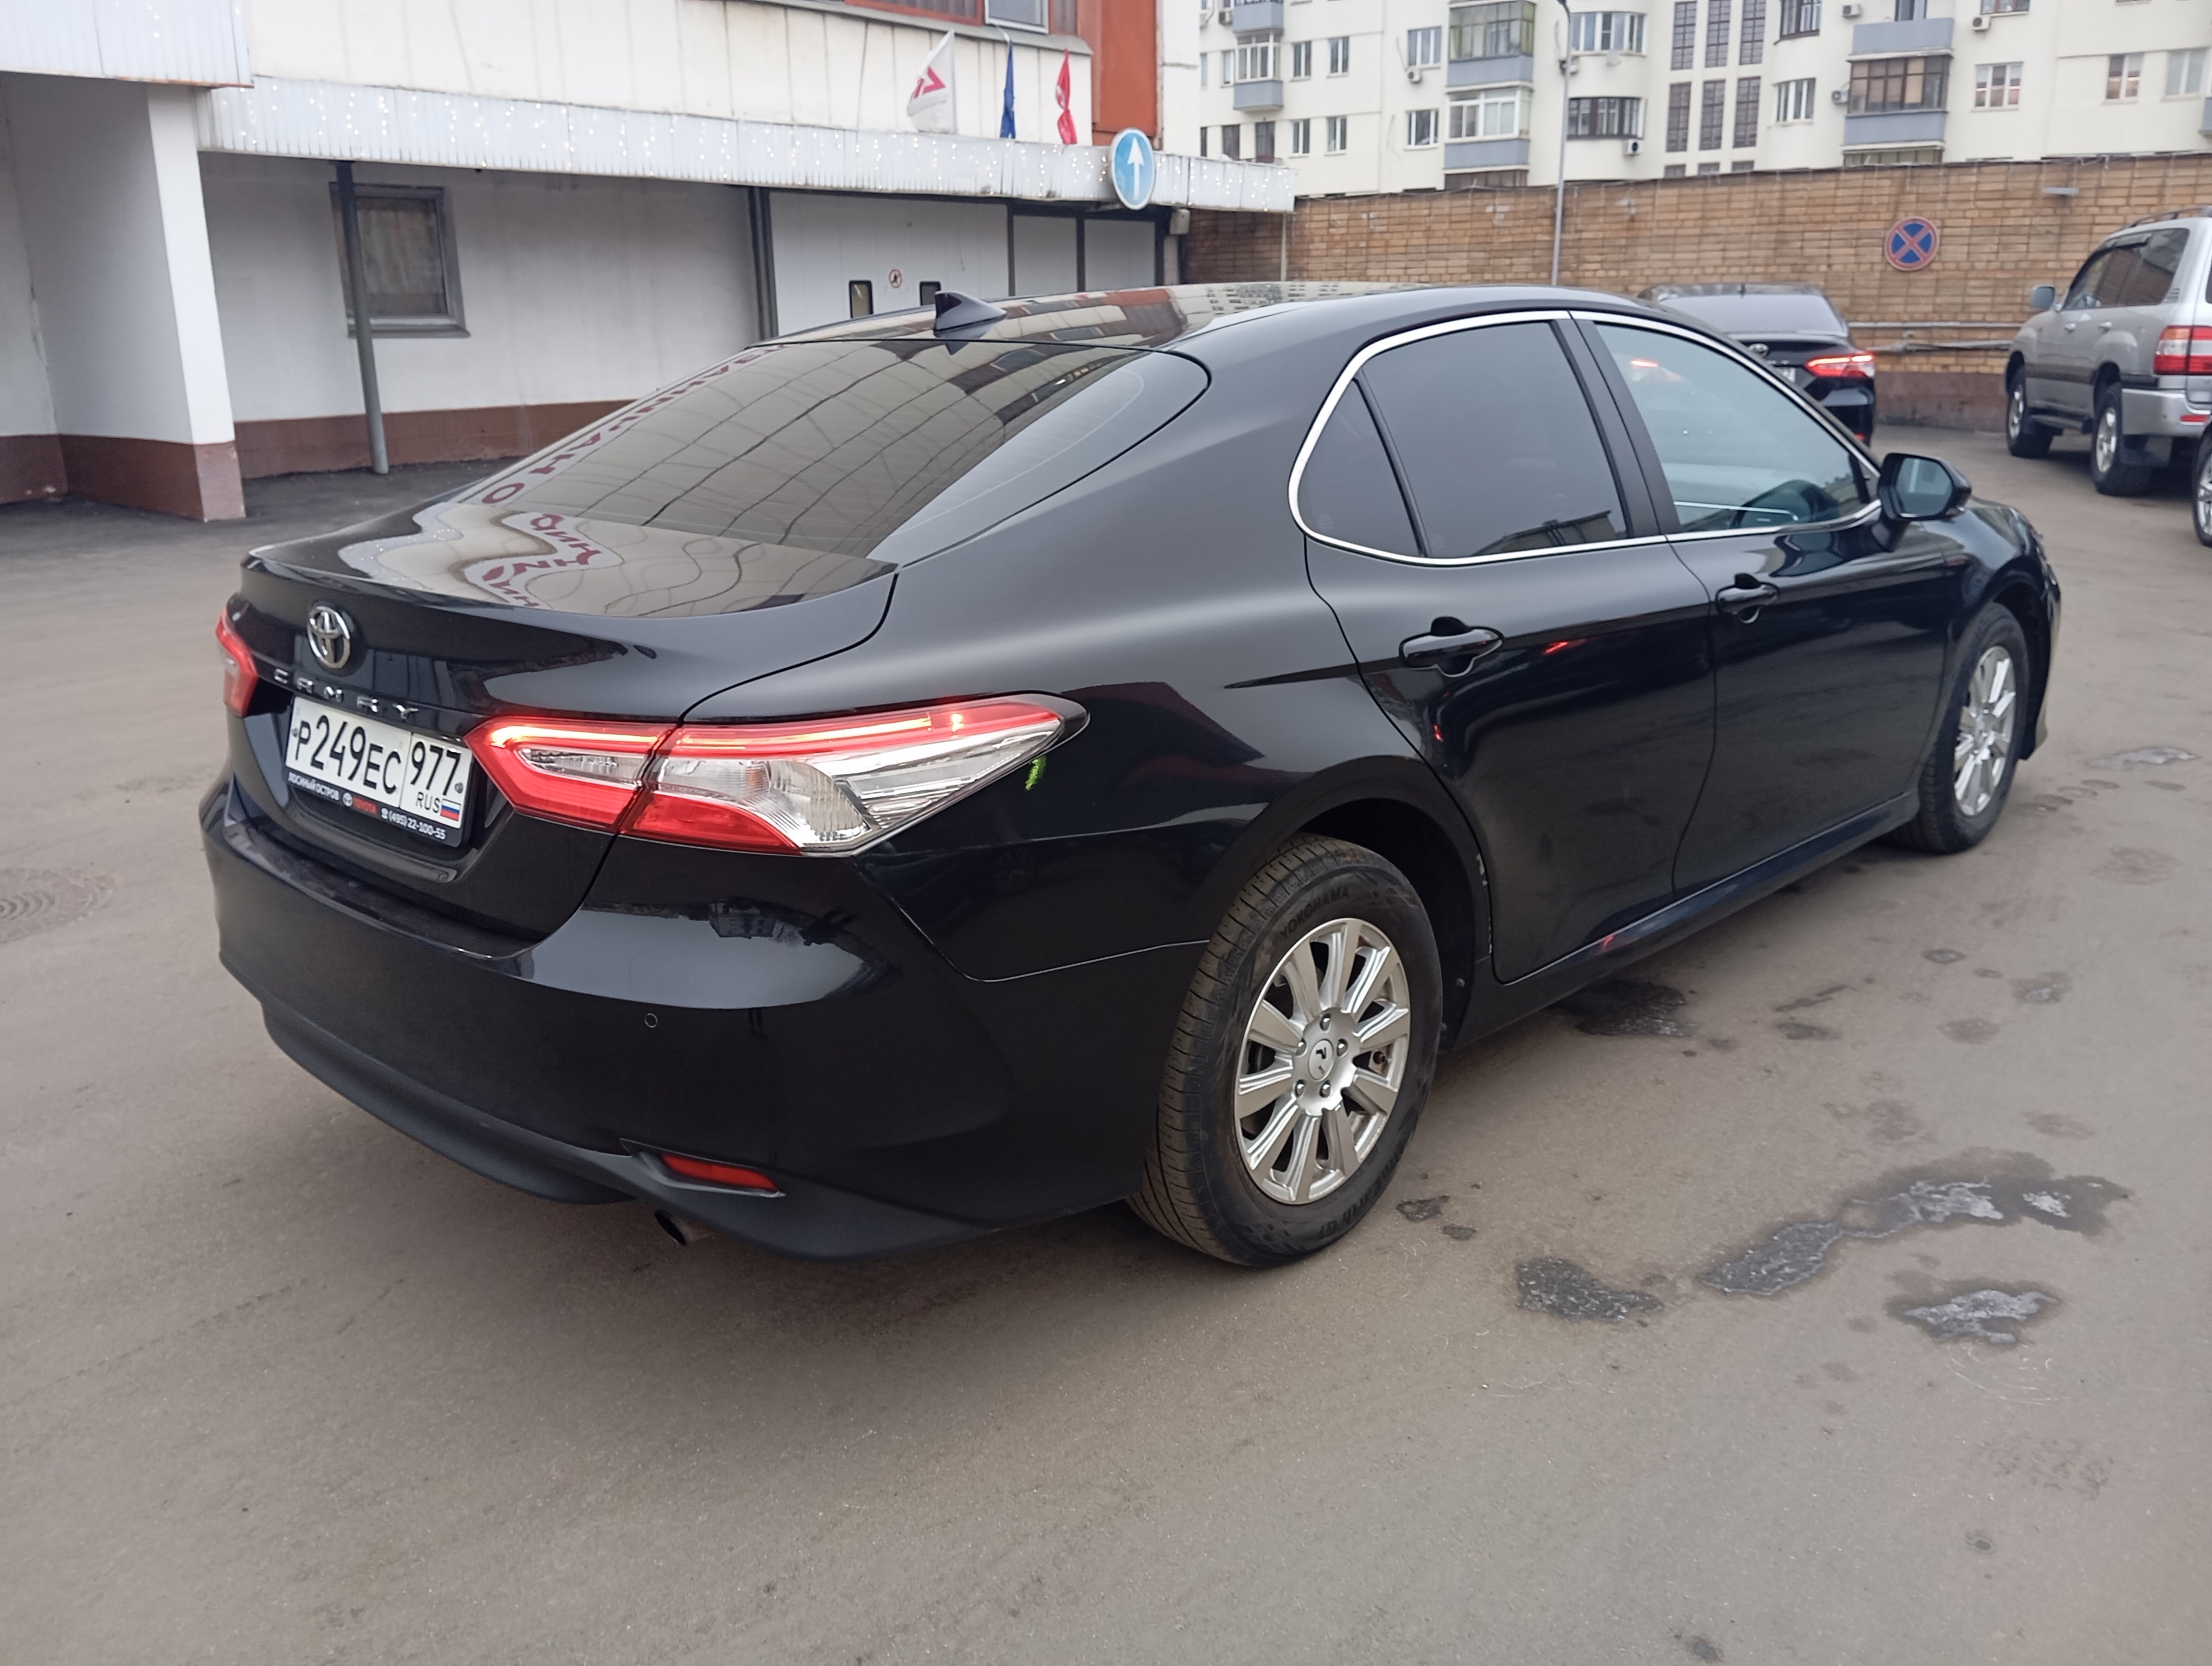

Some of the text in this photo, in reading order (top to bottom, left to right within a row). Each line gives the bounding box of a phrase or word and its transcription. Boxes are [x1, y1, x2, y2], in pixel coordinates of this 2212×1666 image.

[273, 668, 420, 720] CAMRY
[410, 741, 461, 796] 977
[353, 797, 377, 813] TOYOTA
[415, 791, 441, 815] RUS
[1279, 885, 1349, 939] YOKOHAMA
